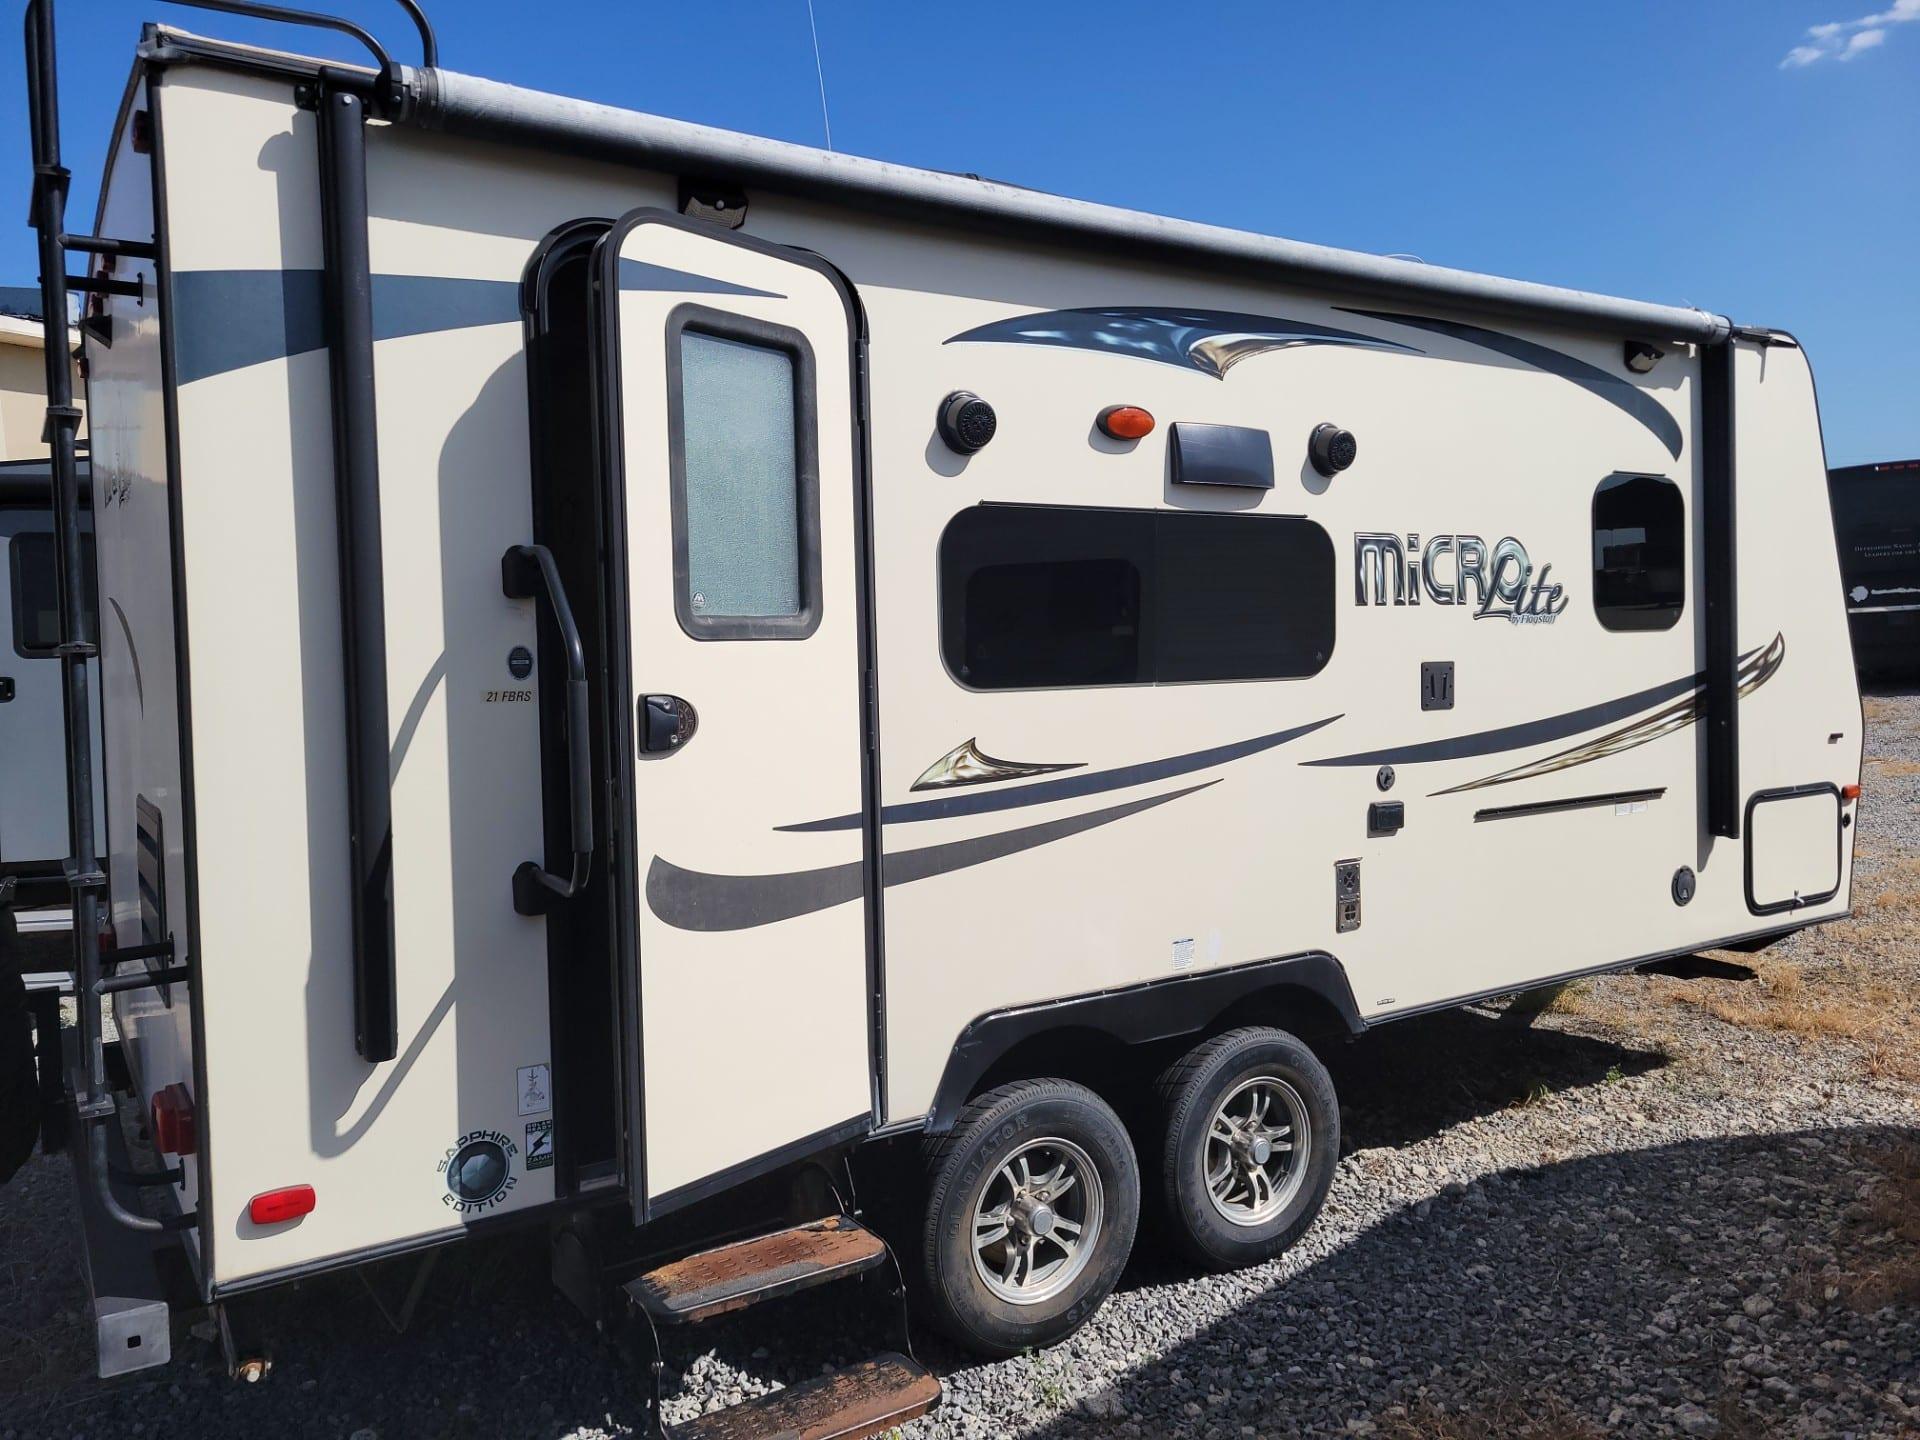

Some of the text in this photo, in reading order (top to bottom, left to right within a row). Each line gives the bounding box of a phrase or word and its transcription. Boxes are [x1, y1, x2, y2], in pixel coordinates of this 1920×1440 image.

[1473, 553, 1569, 621] Lite
[486, 690, 532, 702] 21 FBRS
[436, 1129, 519, 1174] SAPPHIRE
[441, 1176, 518, 1214] EDITION
